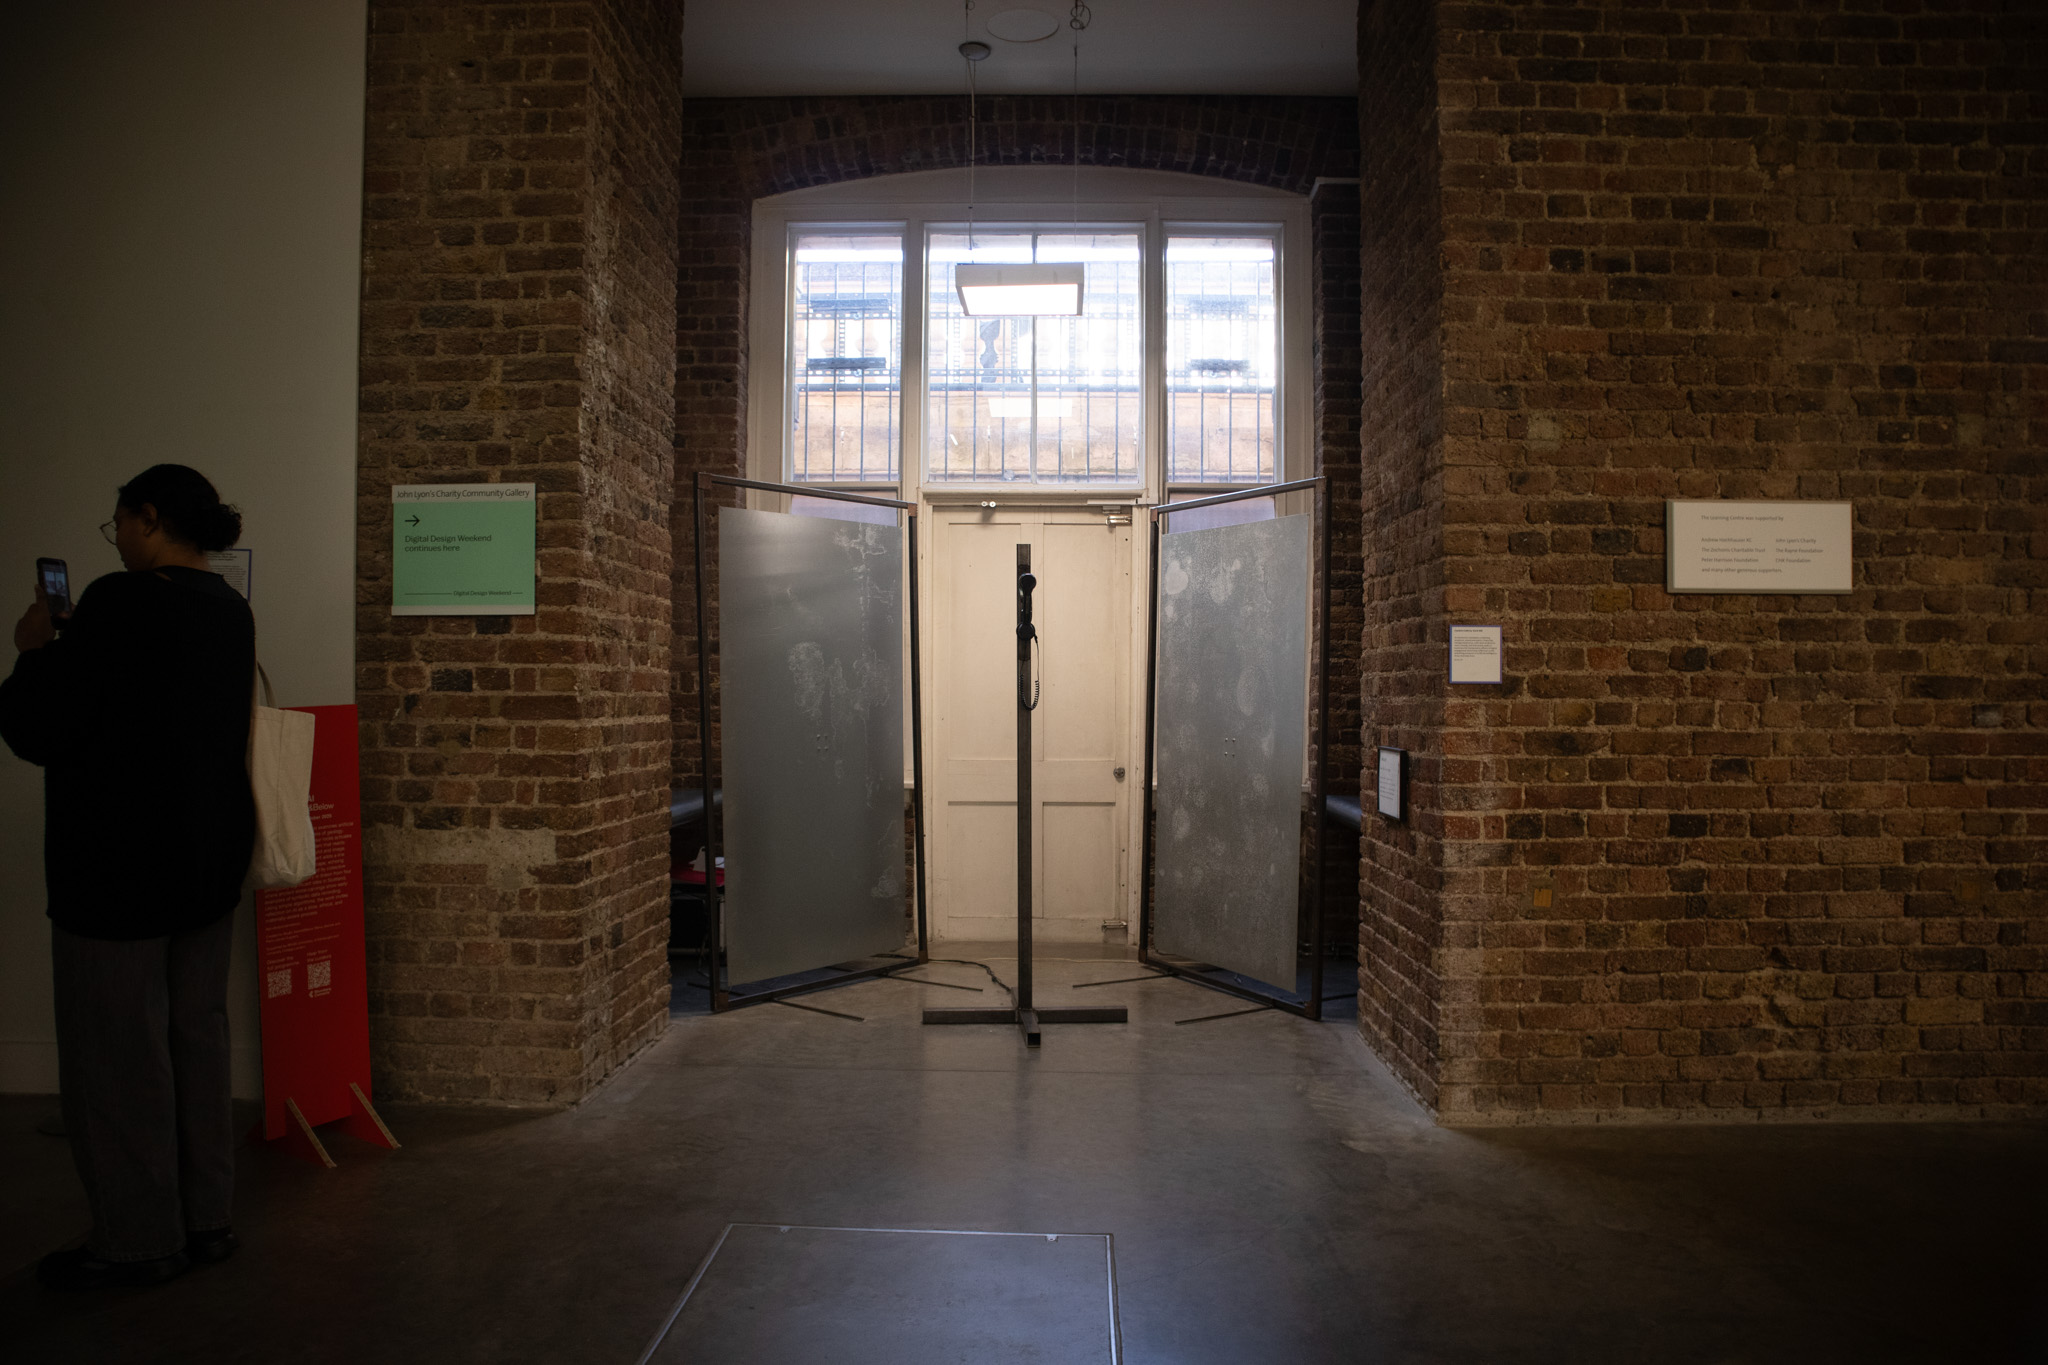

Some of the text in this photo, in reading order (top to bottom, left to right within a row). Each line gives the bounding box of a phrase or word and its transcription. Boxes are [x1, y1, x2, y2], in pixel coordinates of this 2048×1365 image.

[396, 488, 529, 500] John Lyon's Charity Community Gallery
[404, 534, 492, 545] Digital Design Weekend
[404, 544, 461, 553] continues here
